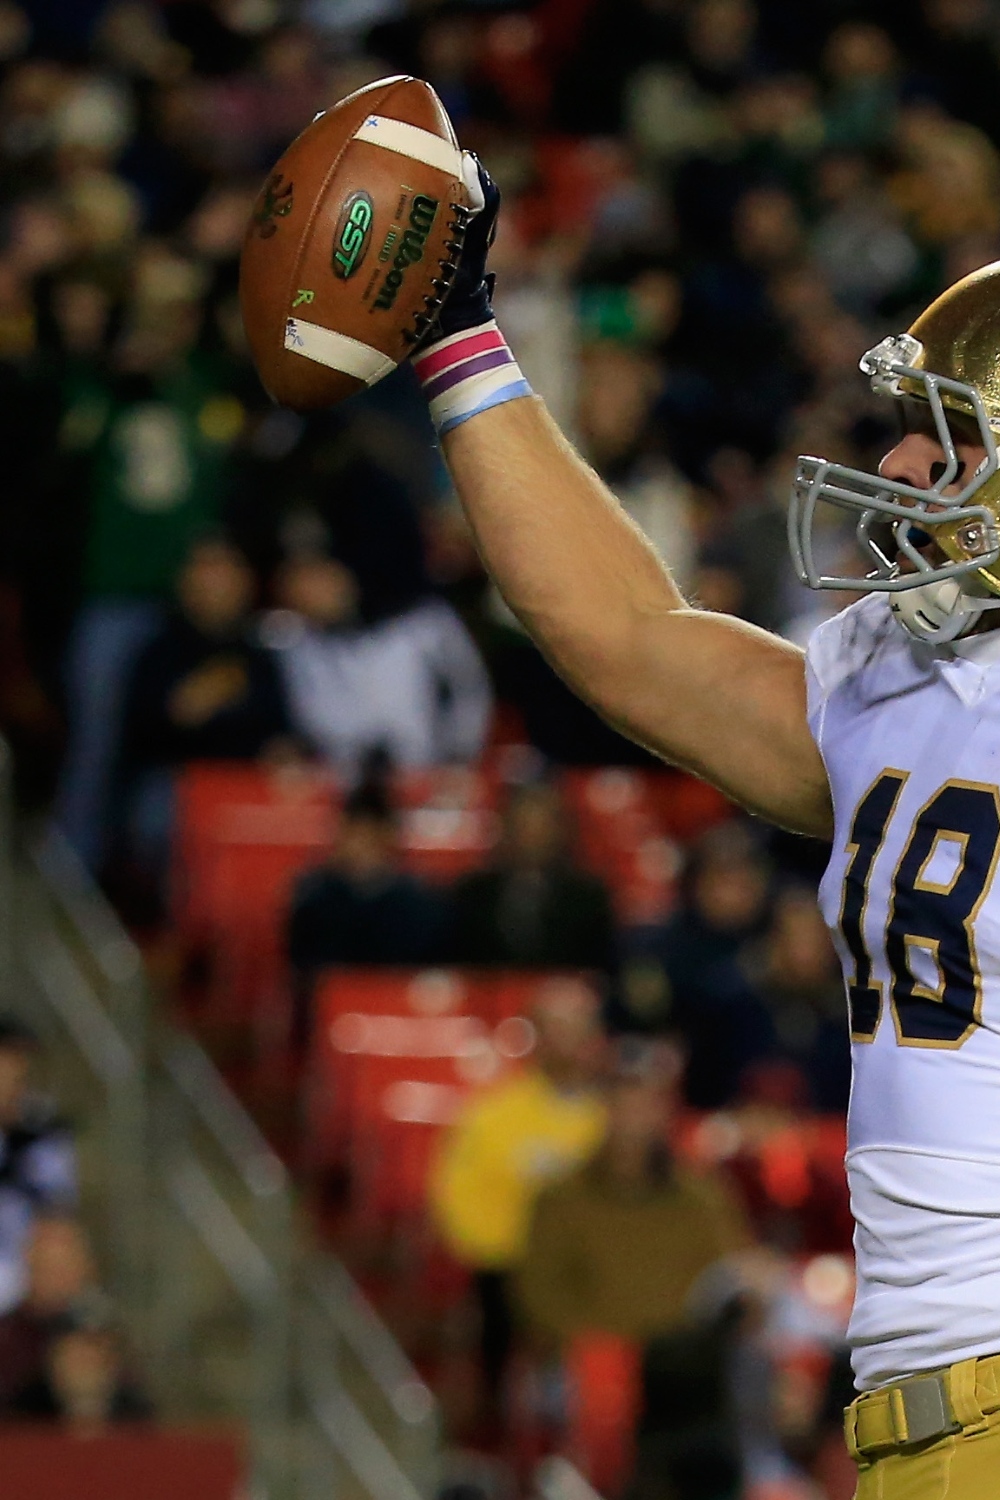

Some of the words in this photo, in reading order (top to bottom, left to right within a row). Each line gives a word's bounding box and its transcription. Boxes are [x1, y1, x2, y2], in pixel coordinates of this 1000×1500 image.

[335, 199, 373, 277] GST
[372, 193, 440, 310] Wilson
[291, 289, 315, 307] R
